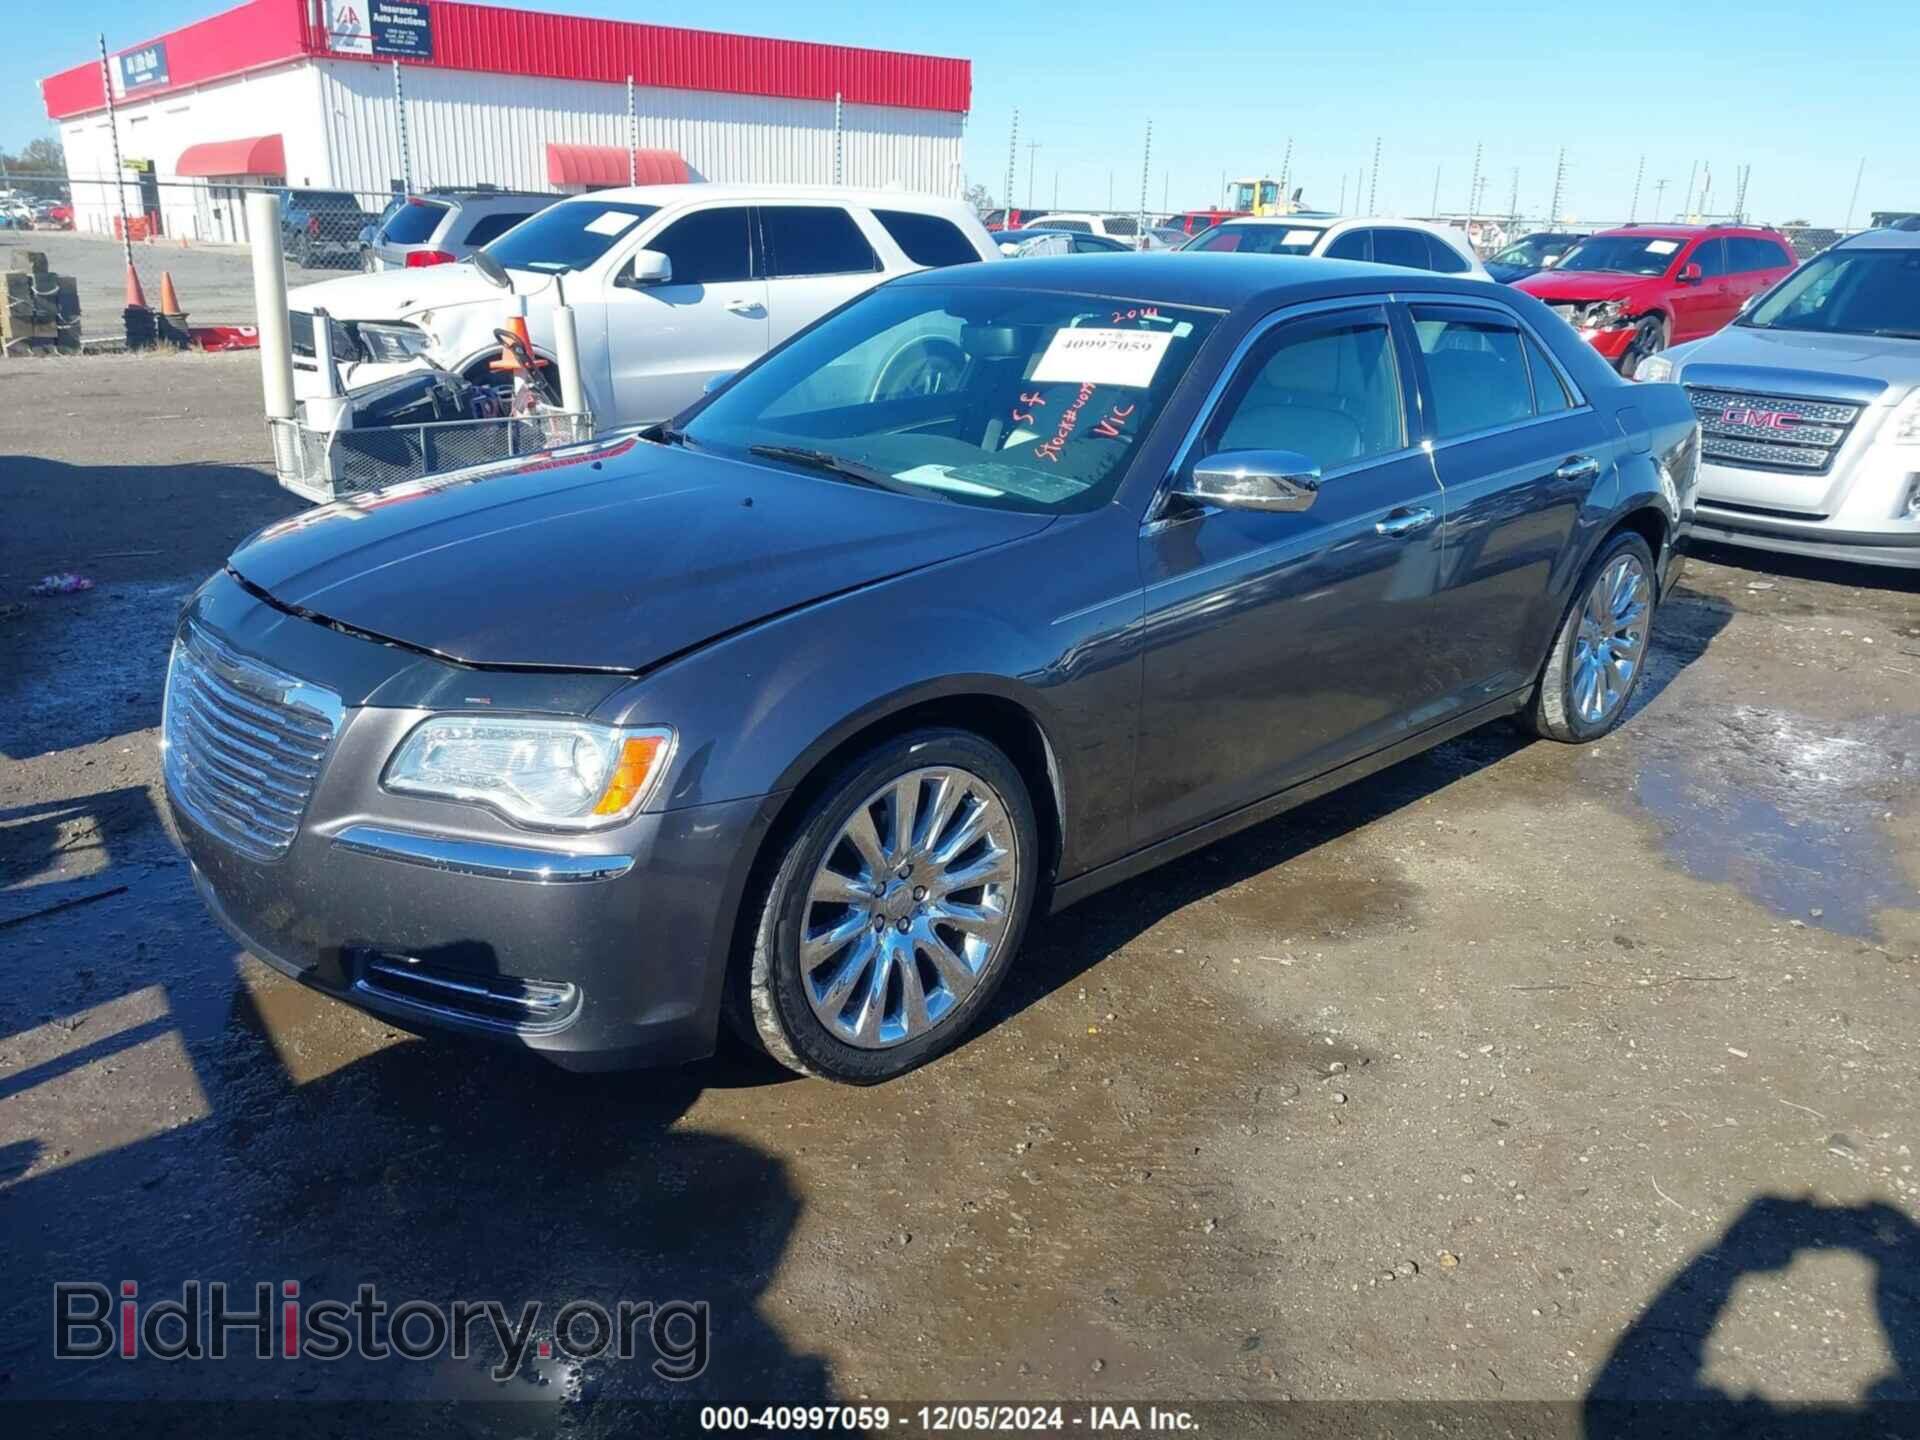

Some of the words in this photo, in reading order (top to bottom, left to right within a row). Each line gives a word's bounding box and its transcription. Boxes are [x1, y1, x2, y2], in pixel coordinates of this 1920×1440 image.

[379, 3, 418, 16] Insurance
[373, 12, 391, 23] Auto
[393, 14, 427, 27] Auctions
[1721, 408, 1801, 431] GMC
